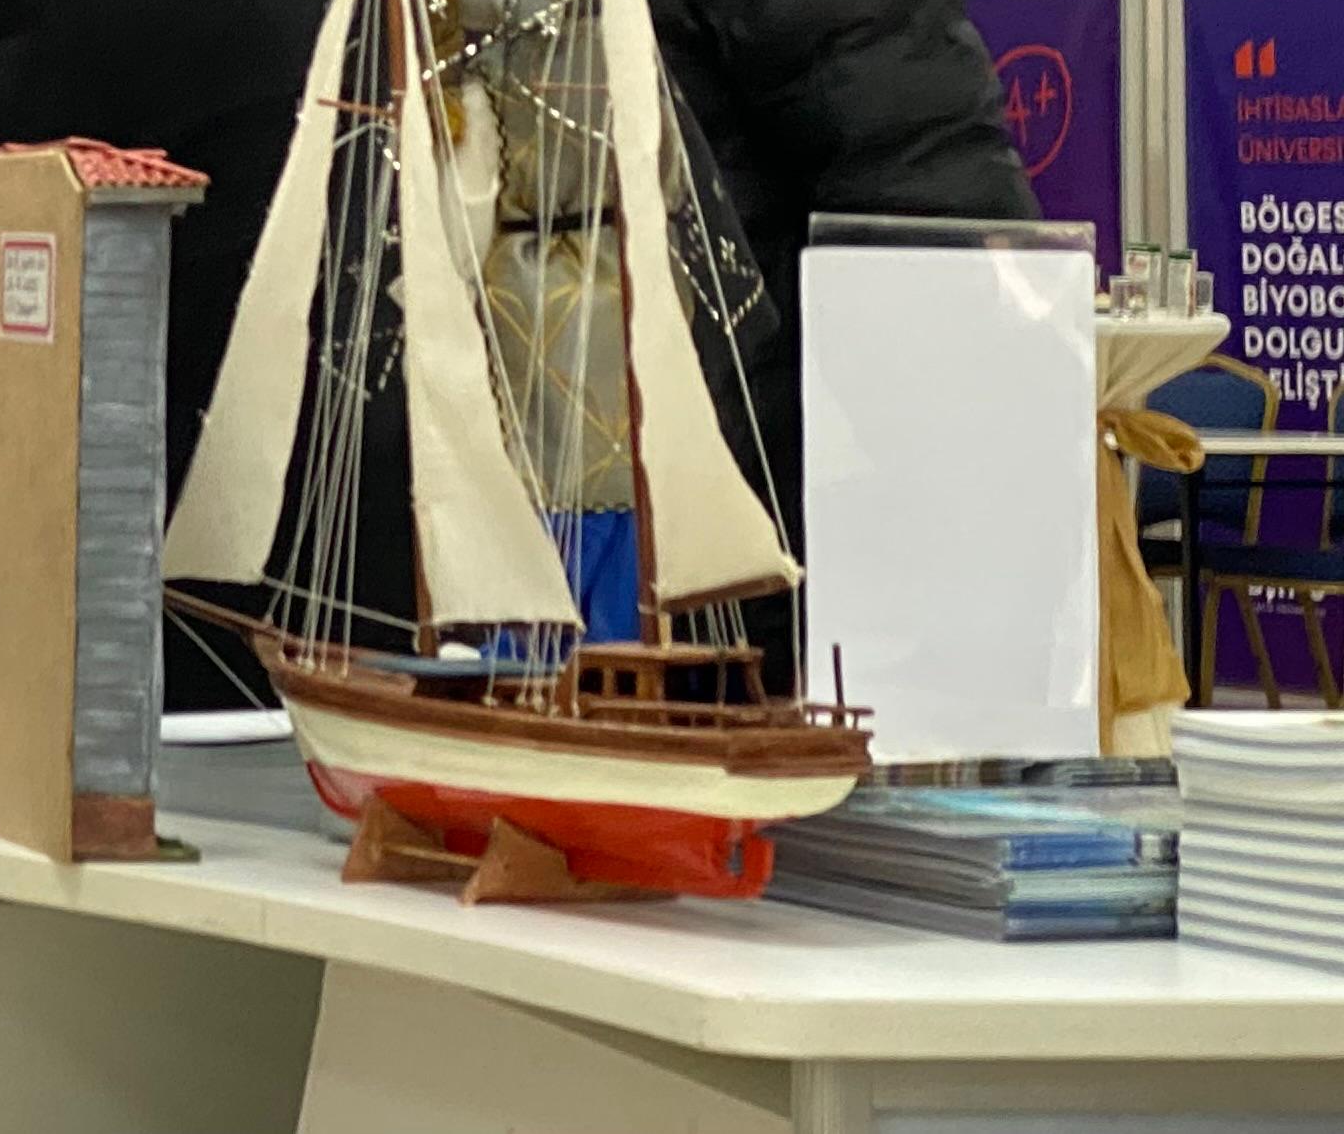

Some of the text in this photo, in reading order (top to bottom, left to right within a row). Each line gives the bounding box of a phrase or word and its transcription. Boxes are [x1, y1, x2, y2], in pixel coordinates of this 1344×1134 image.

[1240, 193, 1344, 233] BÖLGES
[1241, 235, 1344, 275] DOĞAL
[1244, 325, 1344, 360] DOLGU
[1268, 361, 1344, 411] ELİŞT
